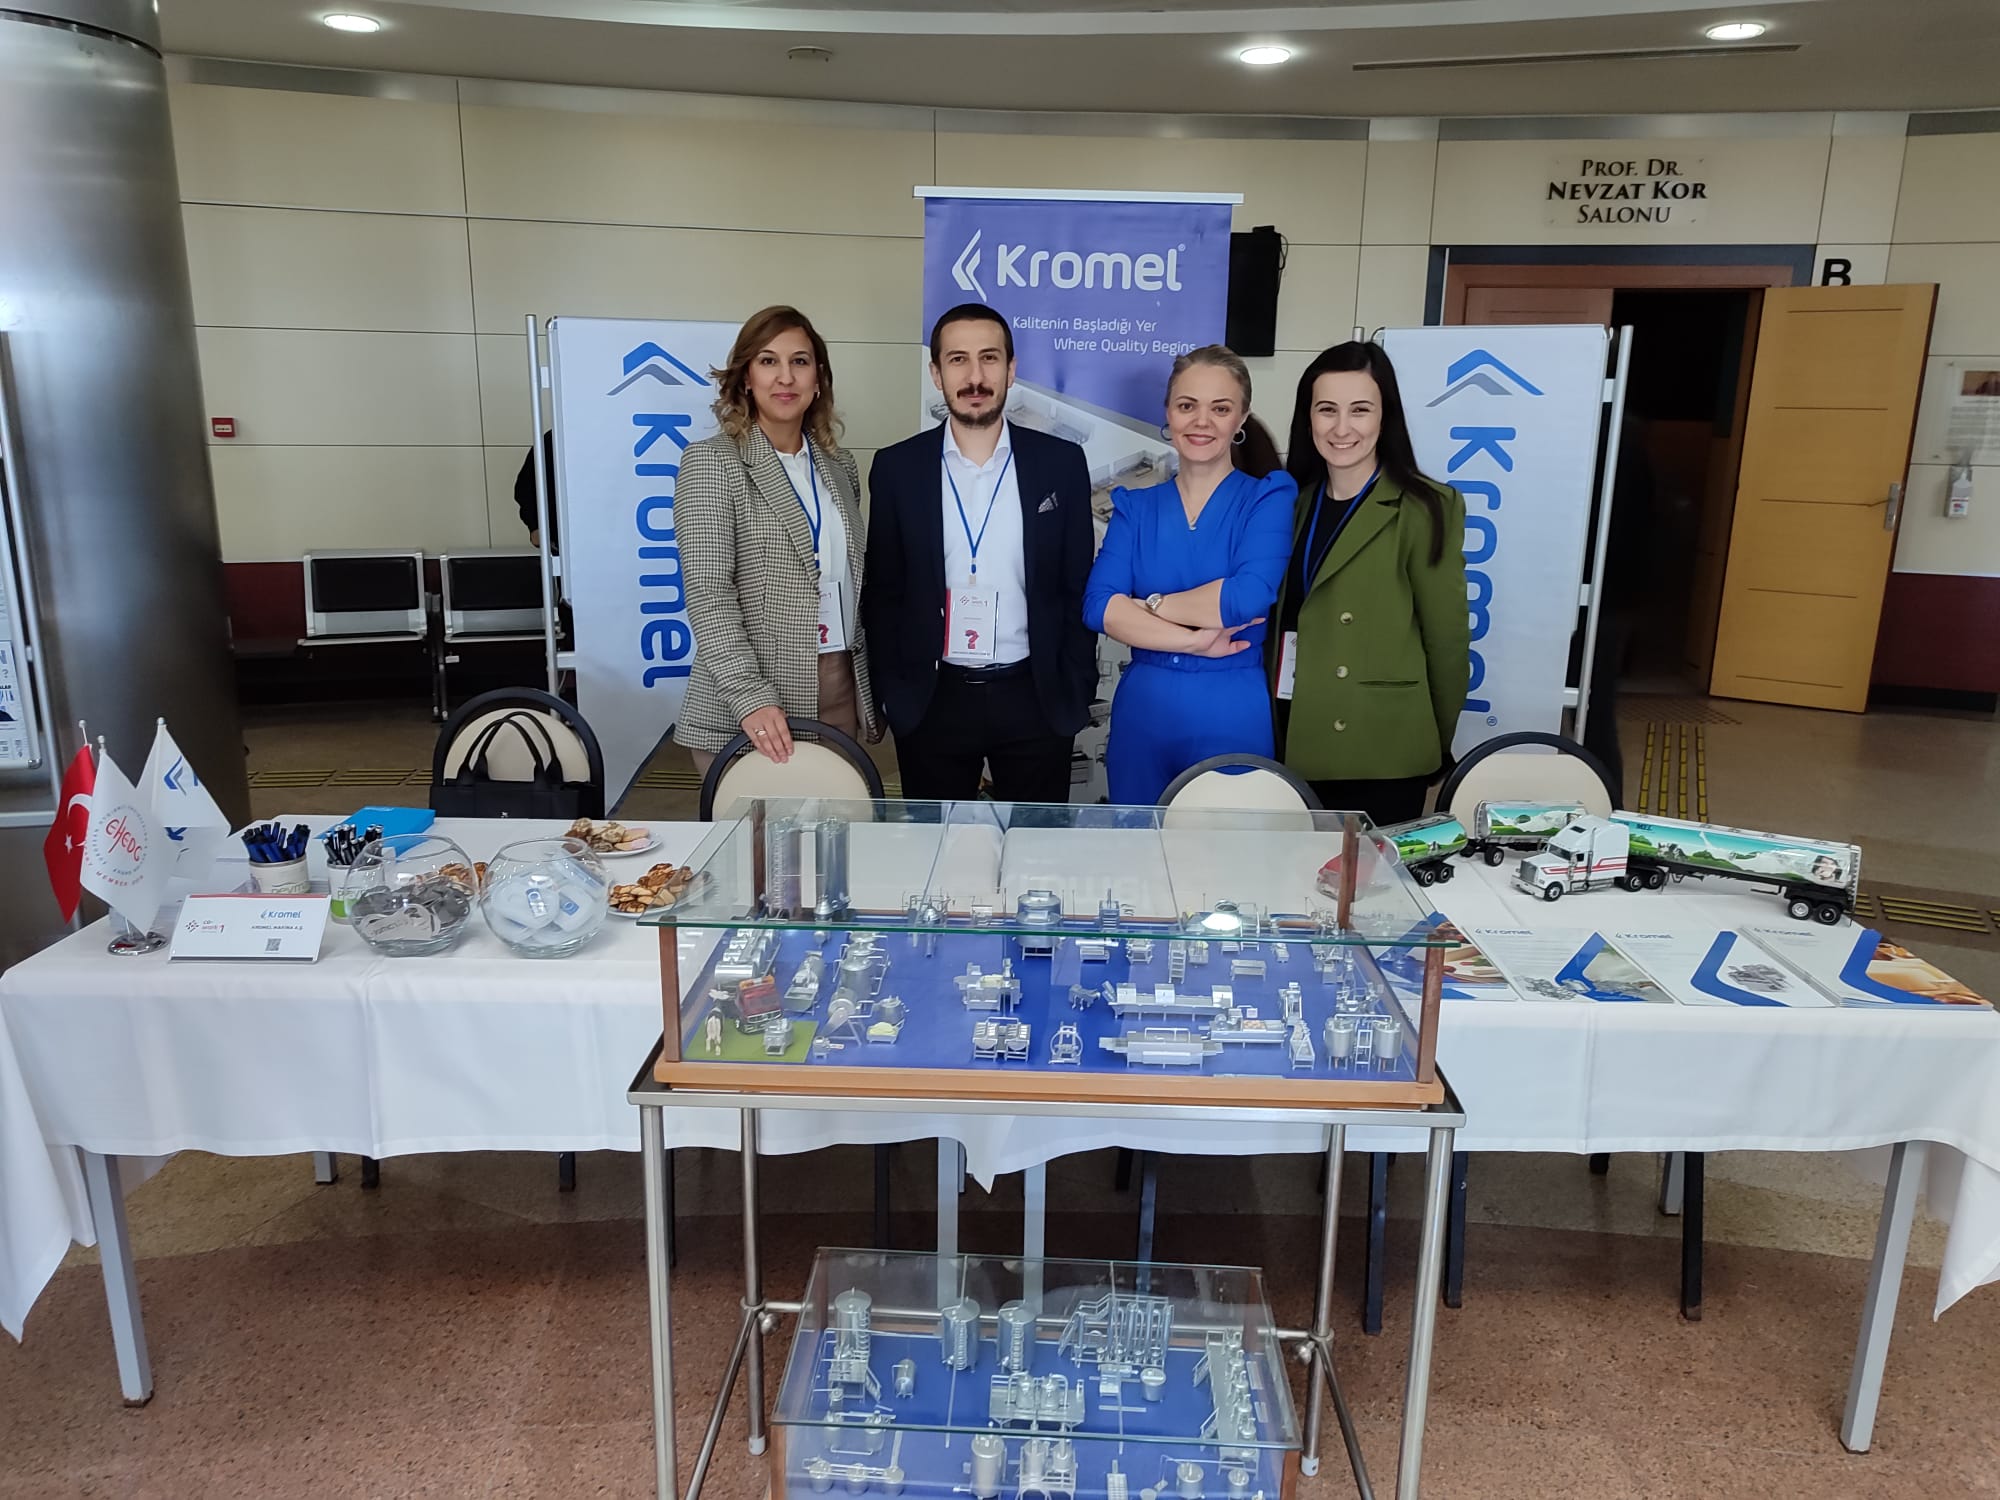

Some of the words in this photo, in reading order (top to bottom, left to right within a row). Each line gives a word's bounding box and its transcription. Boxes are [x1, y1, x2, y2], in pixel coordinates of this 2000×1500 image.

[1546, 181, 1646, 200] NEVZAT
[1651, 181, 1708, 200] KOR
[1577, 205, 1671, 224] SALONU
[1012, 316, 1070, 331] Kalitenin
[1073, 316, 1132, 334] Başladığı
[1136, 318, 1157, 332] Yer
[1054, 337, 1097, 352] Where
[1100, 338, 1149, 356] Quality
[1152, 339, 1197, 356] Begins
[268, 910, 303, 919] Kromel
